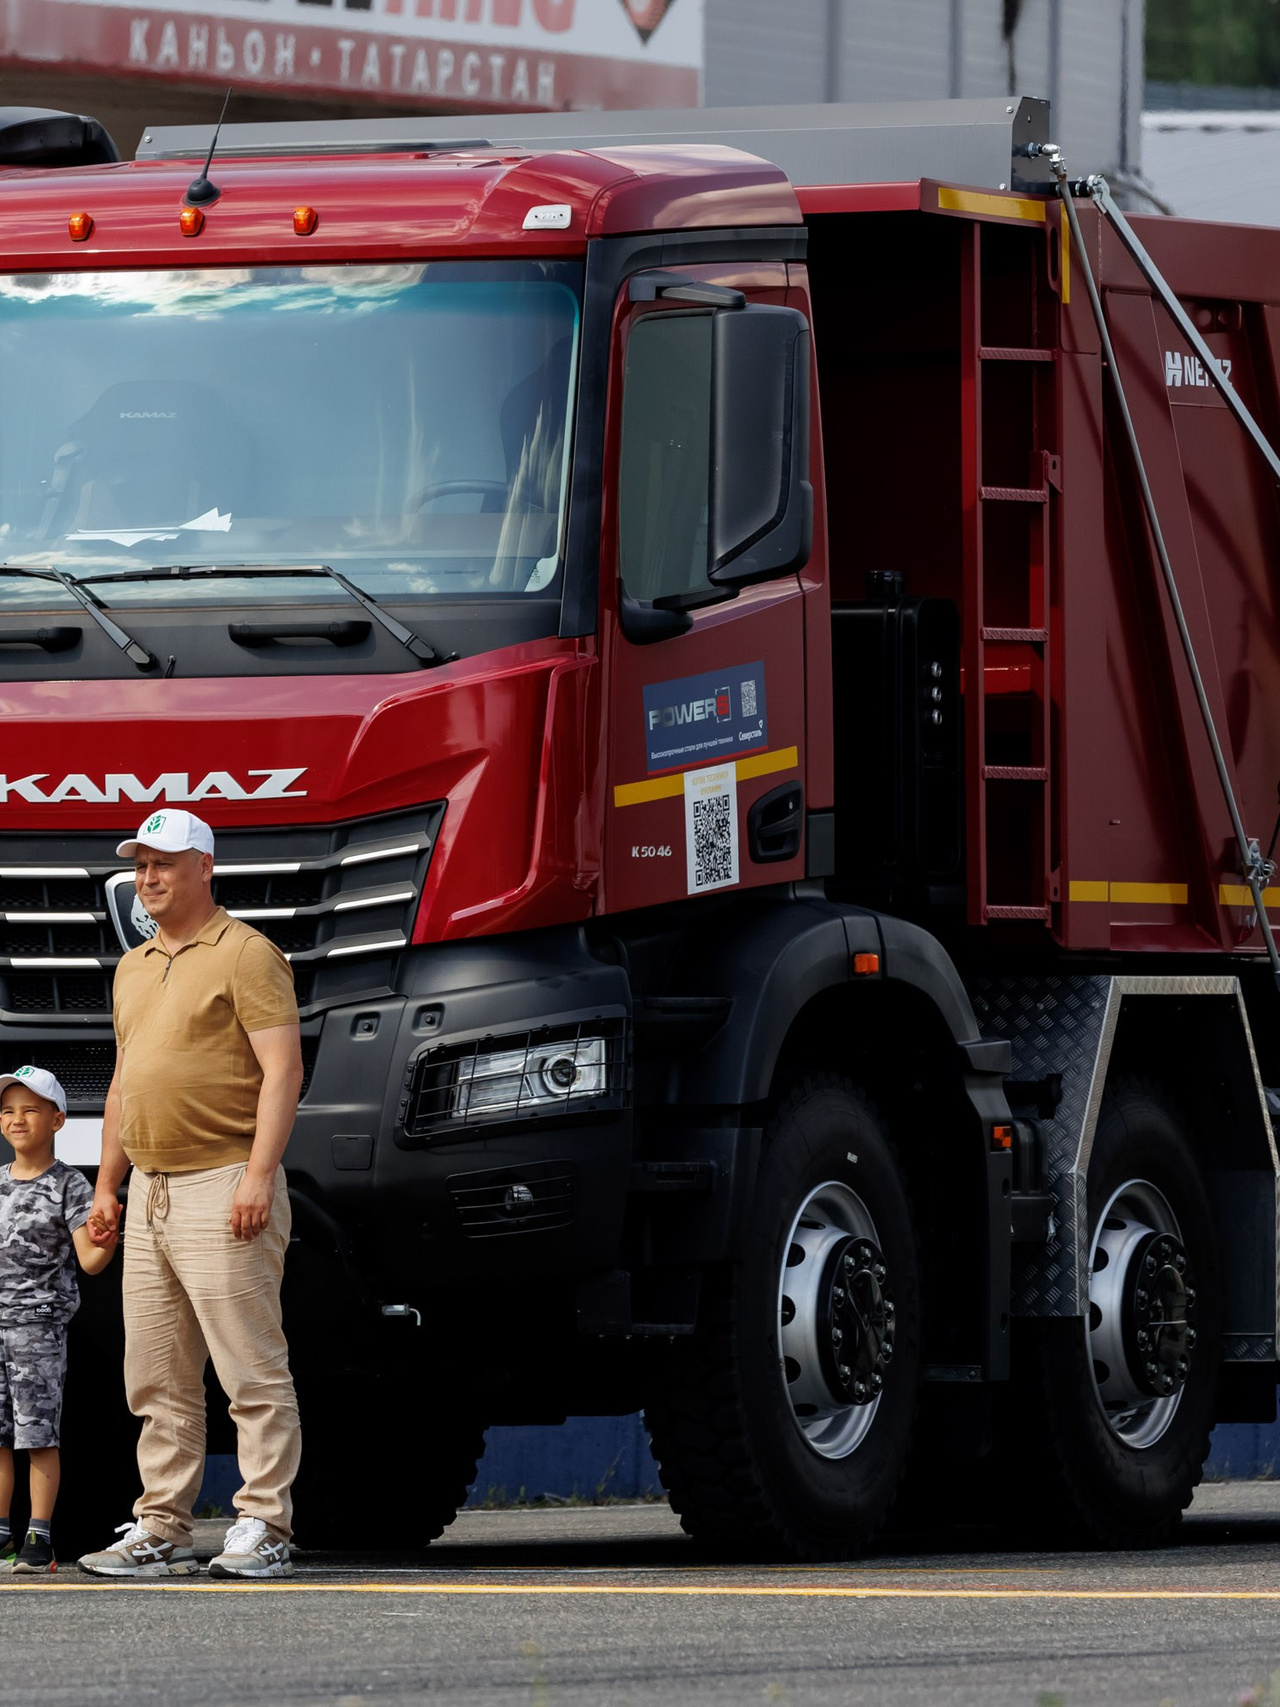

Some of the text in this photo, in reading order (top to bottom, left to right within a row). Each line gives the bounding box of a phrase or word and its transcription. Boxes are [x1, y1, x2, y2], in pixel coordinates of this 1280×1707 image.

[128, 18, 556, 101] КАНЬОН ТАТАРСТАН
[1184, 356, 1233, 388] NEZ
[120, 411, 177, 419] KAMAZ
[738, 729, 762, 741] Северсталь
[651, 747, 684, 760] Высокопрочные
